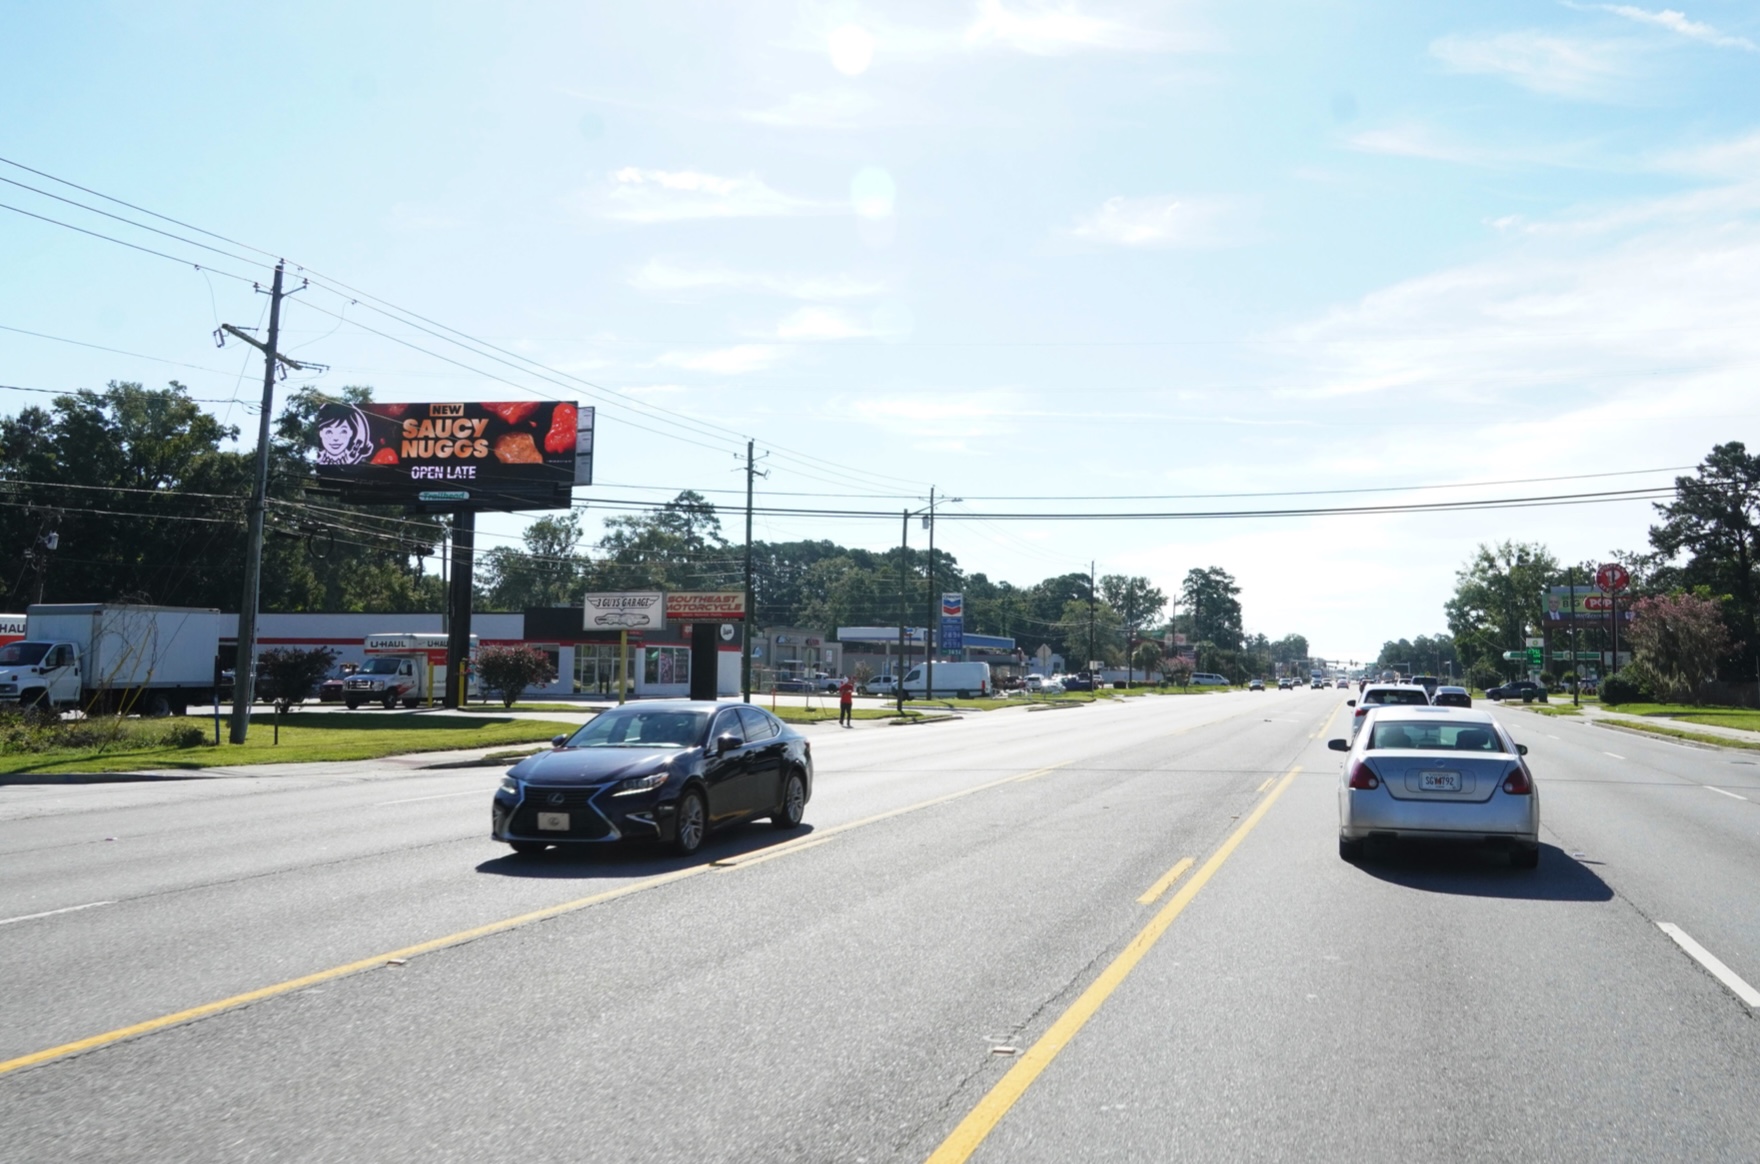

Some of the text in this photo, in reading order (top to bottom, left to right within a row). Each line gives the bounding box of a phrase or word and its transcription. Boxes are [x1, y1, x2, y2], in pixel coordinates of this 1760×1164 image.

[432, 405, 462, 415] NEW
[402, 418, 489, 439] SAUCY
[401, 439, 489, 458] NUGGS
[411, 466, 477, 479] OPEN LATE
[622, 598, 650, 607] GARAGE
[668, 595, 738, 603] SOUTHEAST
[667, 603, 742, 611] MOTORCYCLE
[370, 640, 406, 648] U-HAUL
